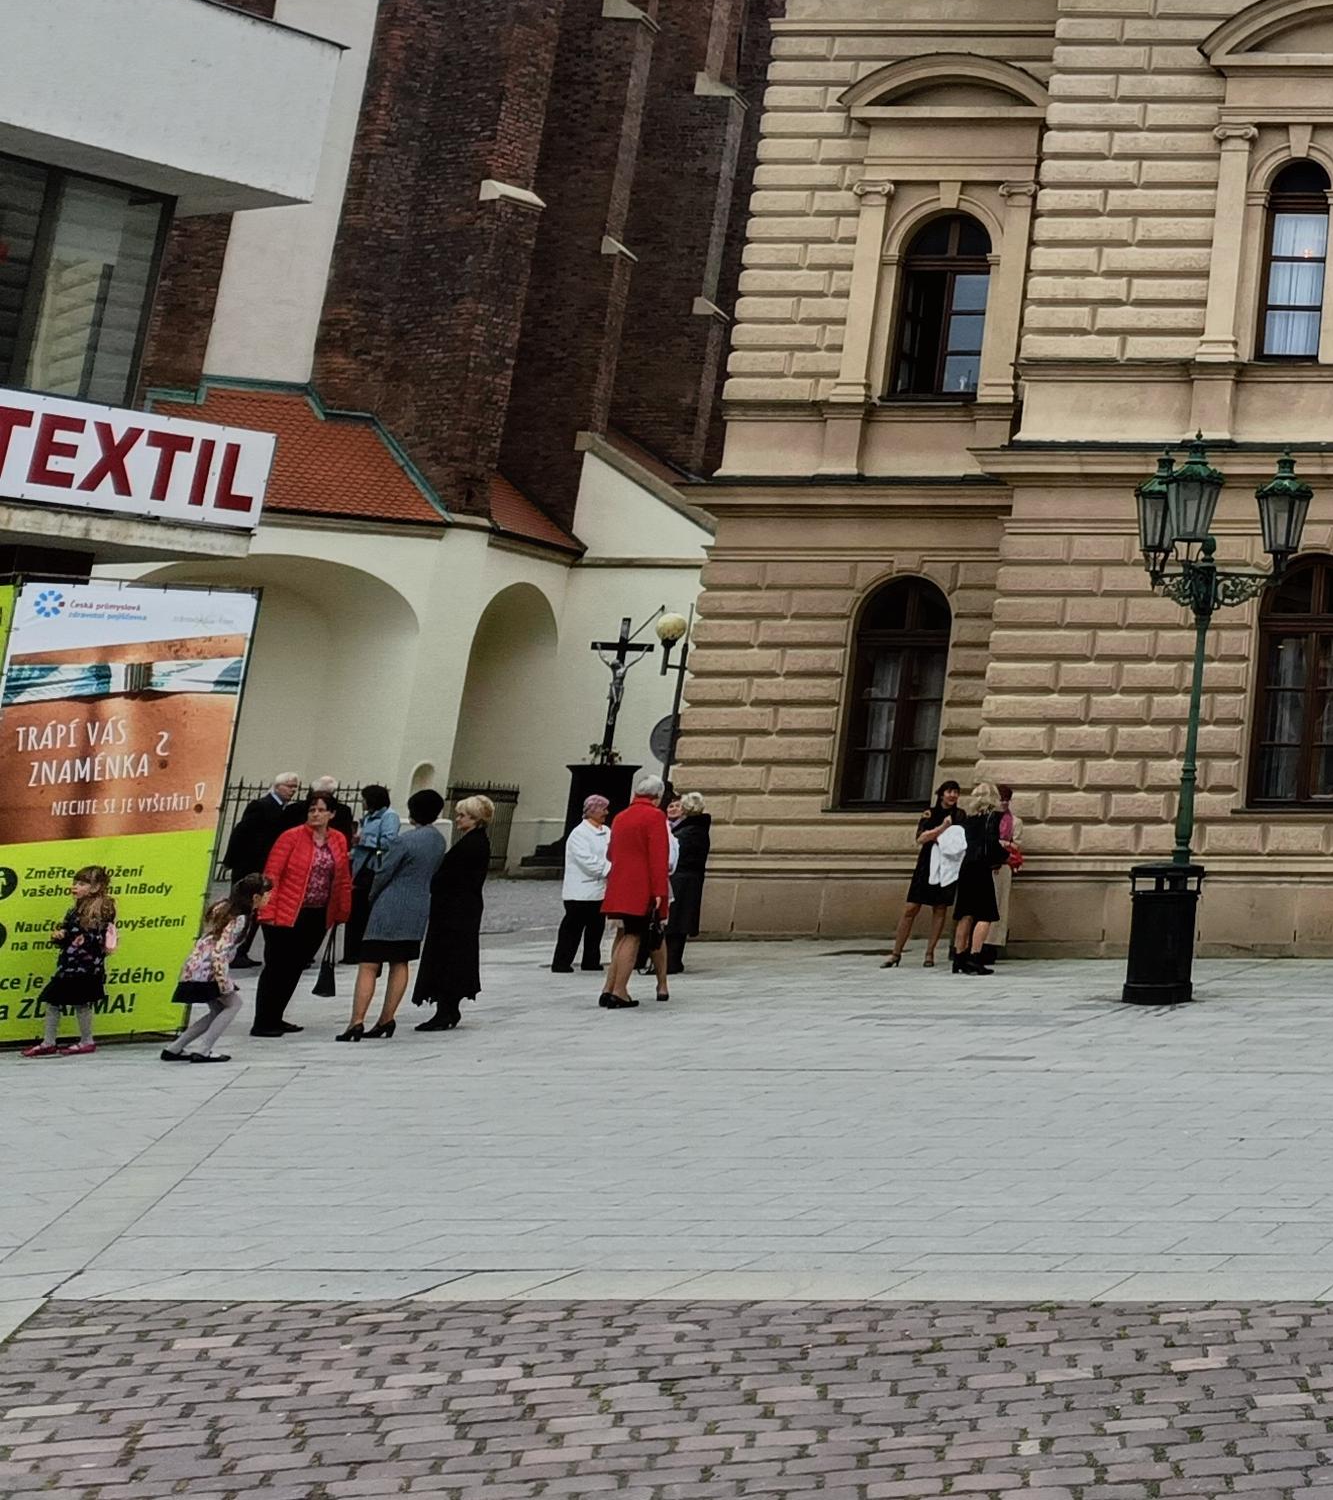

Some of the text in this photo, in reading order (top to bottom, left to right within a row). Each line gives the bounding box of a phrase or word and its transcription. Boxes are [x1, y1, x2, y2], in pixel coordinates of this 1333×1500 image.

[0, 405, 253, 513] TEXTIL
[16, 715, 128, 752] TRÁPÍ VÁS
[27, 751, 150, 787] ZNAMÉNKA
[24, 866, 75, 879] Změřte
[22, 884, 72, 897] vašeho
[125, 882, 173, 897] InBody
[11, 941, 28, 951] na
[25, 973, 44, 993] je
